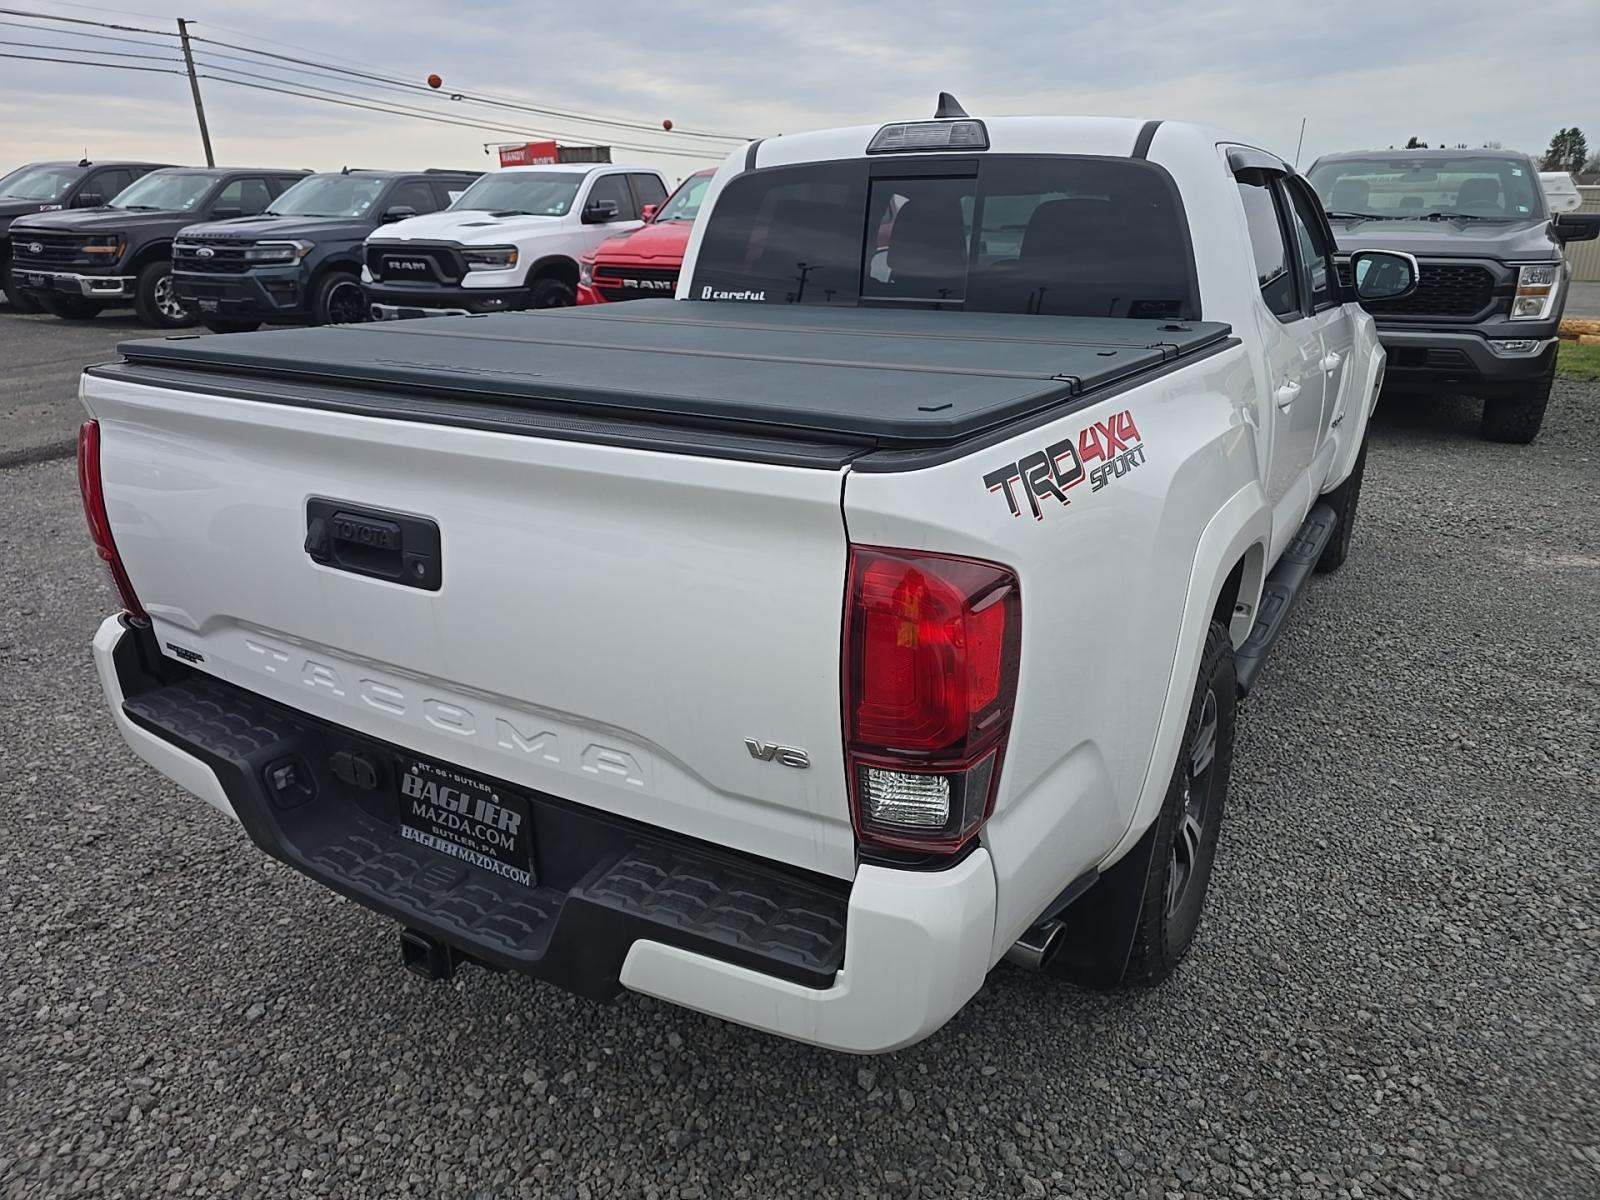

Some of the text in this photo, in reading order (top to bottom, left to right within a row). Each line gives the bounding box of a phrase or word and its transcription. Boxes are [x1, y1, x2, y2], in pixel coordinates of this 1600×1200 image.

[388, 261, 426, 270] RAM
[623, 279, 671, 289] RAM
[713, 291, 766, 301] careful
[982, 438, 1086, 521] TRD
[1089, 443, 1146, 493] SPORT
[333, 519, 390, 542] TOYOTA
[245, 639, 645, 787] TACOMA
[743, 738, 811, 769] V6
[401, 772, 522, 836] BAGLIER
[412, 800, 515, 852] MAZDA.COM
[482, 844, 498, 857] PA
